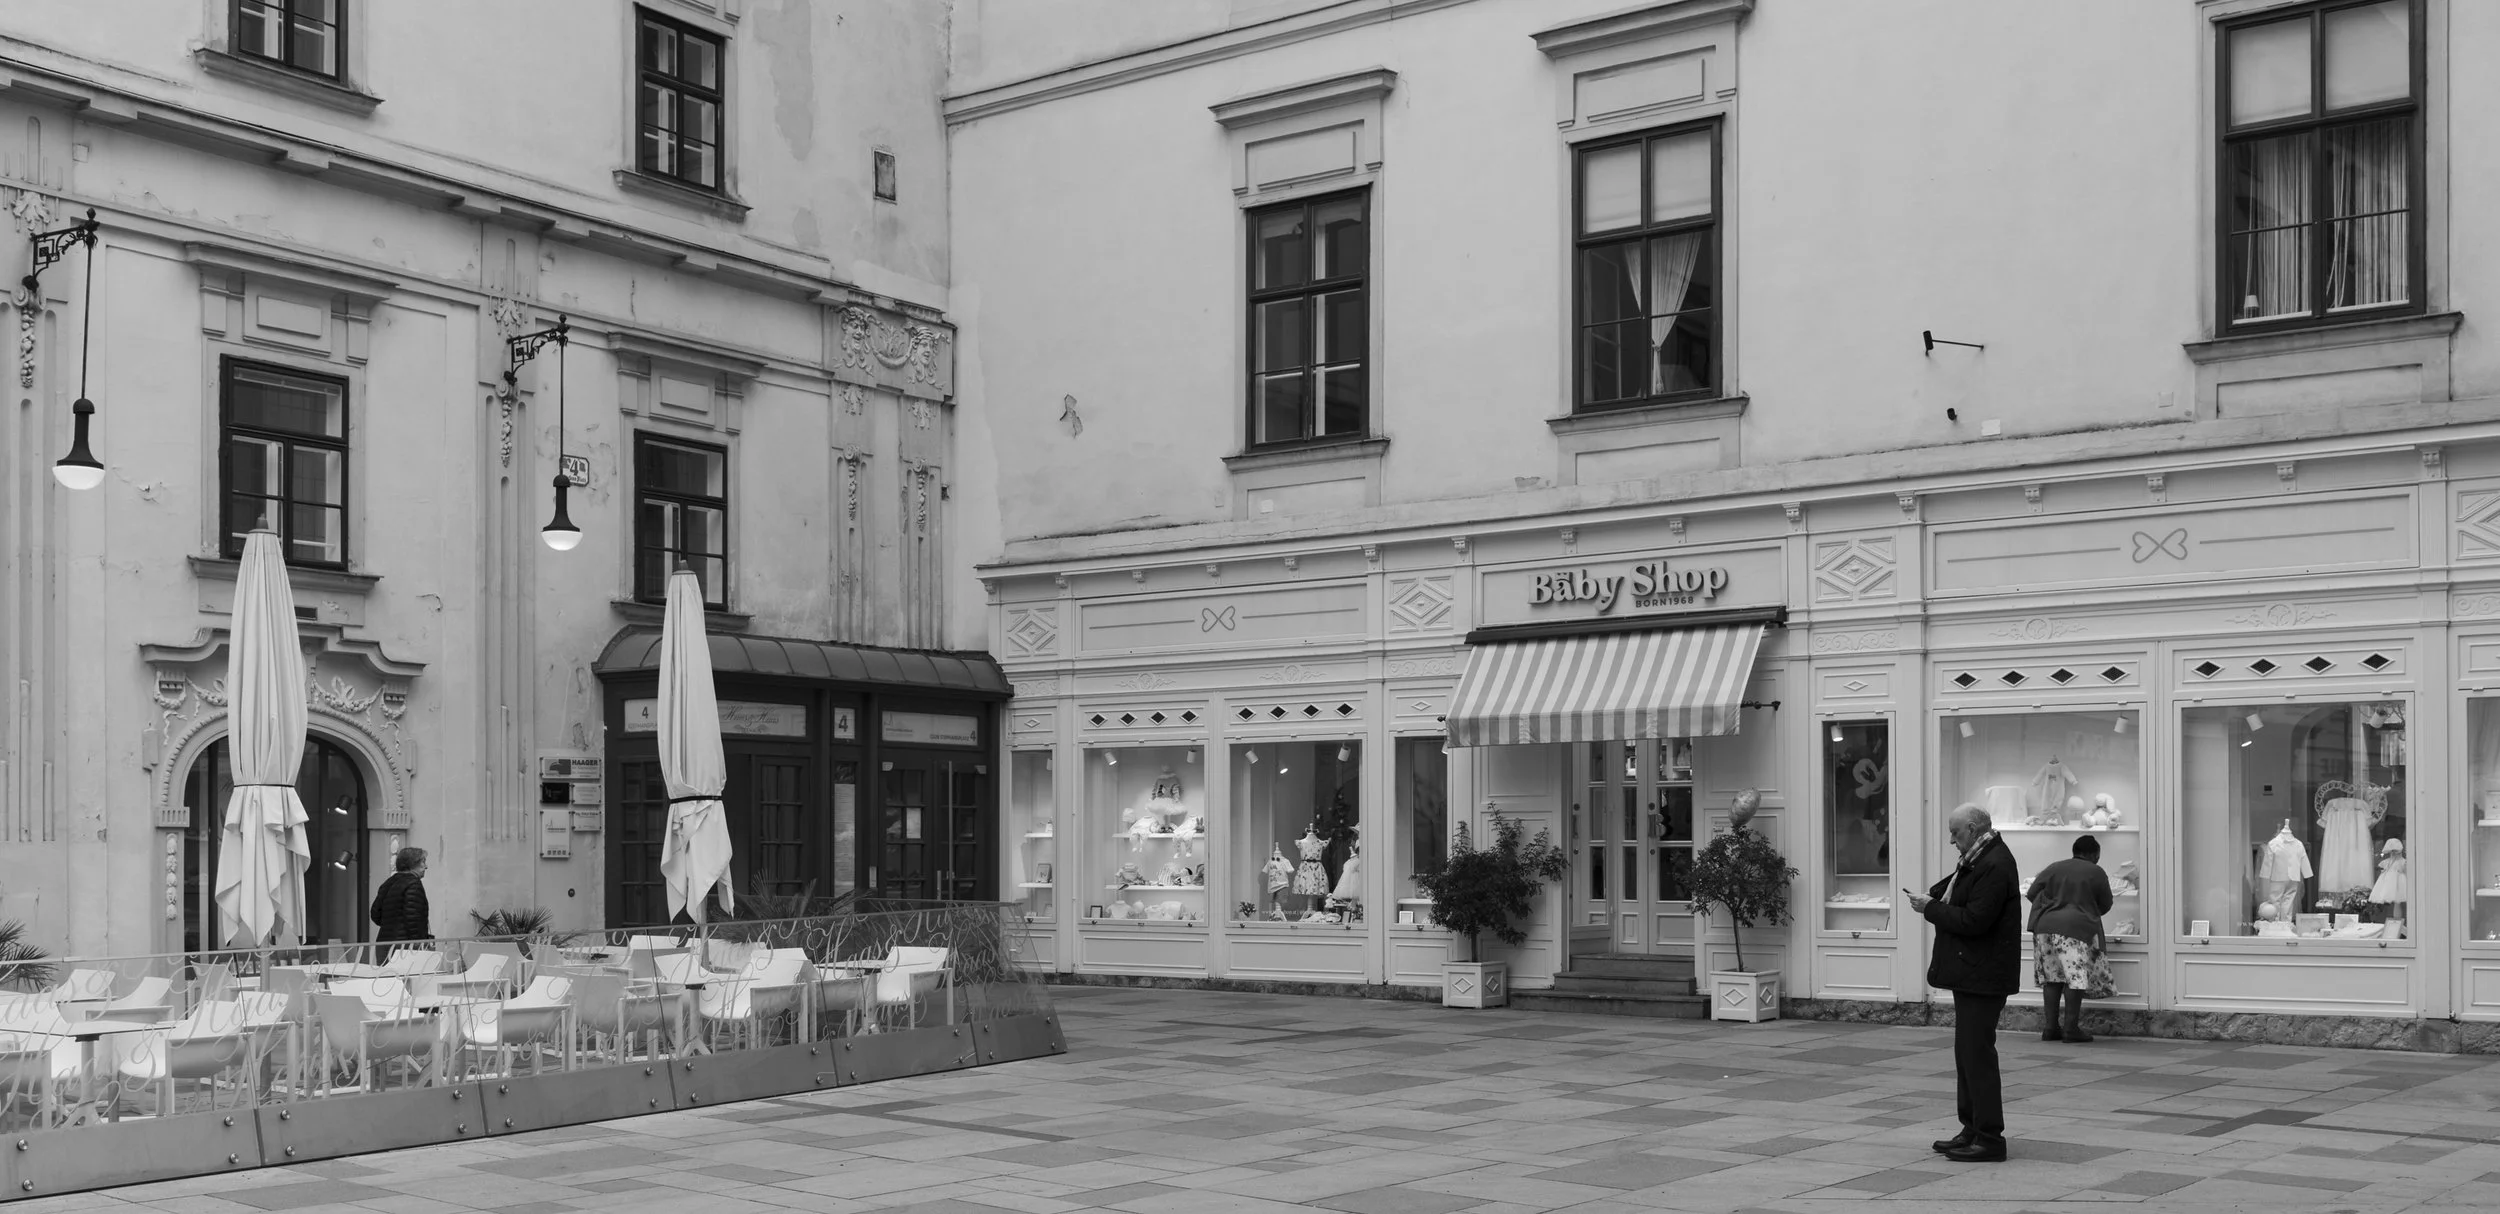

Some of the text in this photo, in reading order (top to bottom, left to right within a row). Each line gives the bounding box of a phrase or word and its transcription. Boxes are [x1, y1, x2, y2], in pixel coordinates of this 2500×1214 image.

[569, 459, 579, 476] 4
[1632, 559, 1728, 599] Shop
[641, 706, 649, 719] 4
[838, 714, 848, 732] 4
[970, 730, 976, 742] 4
